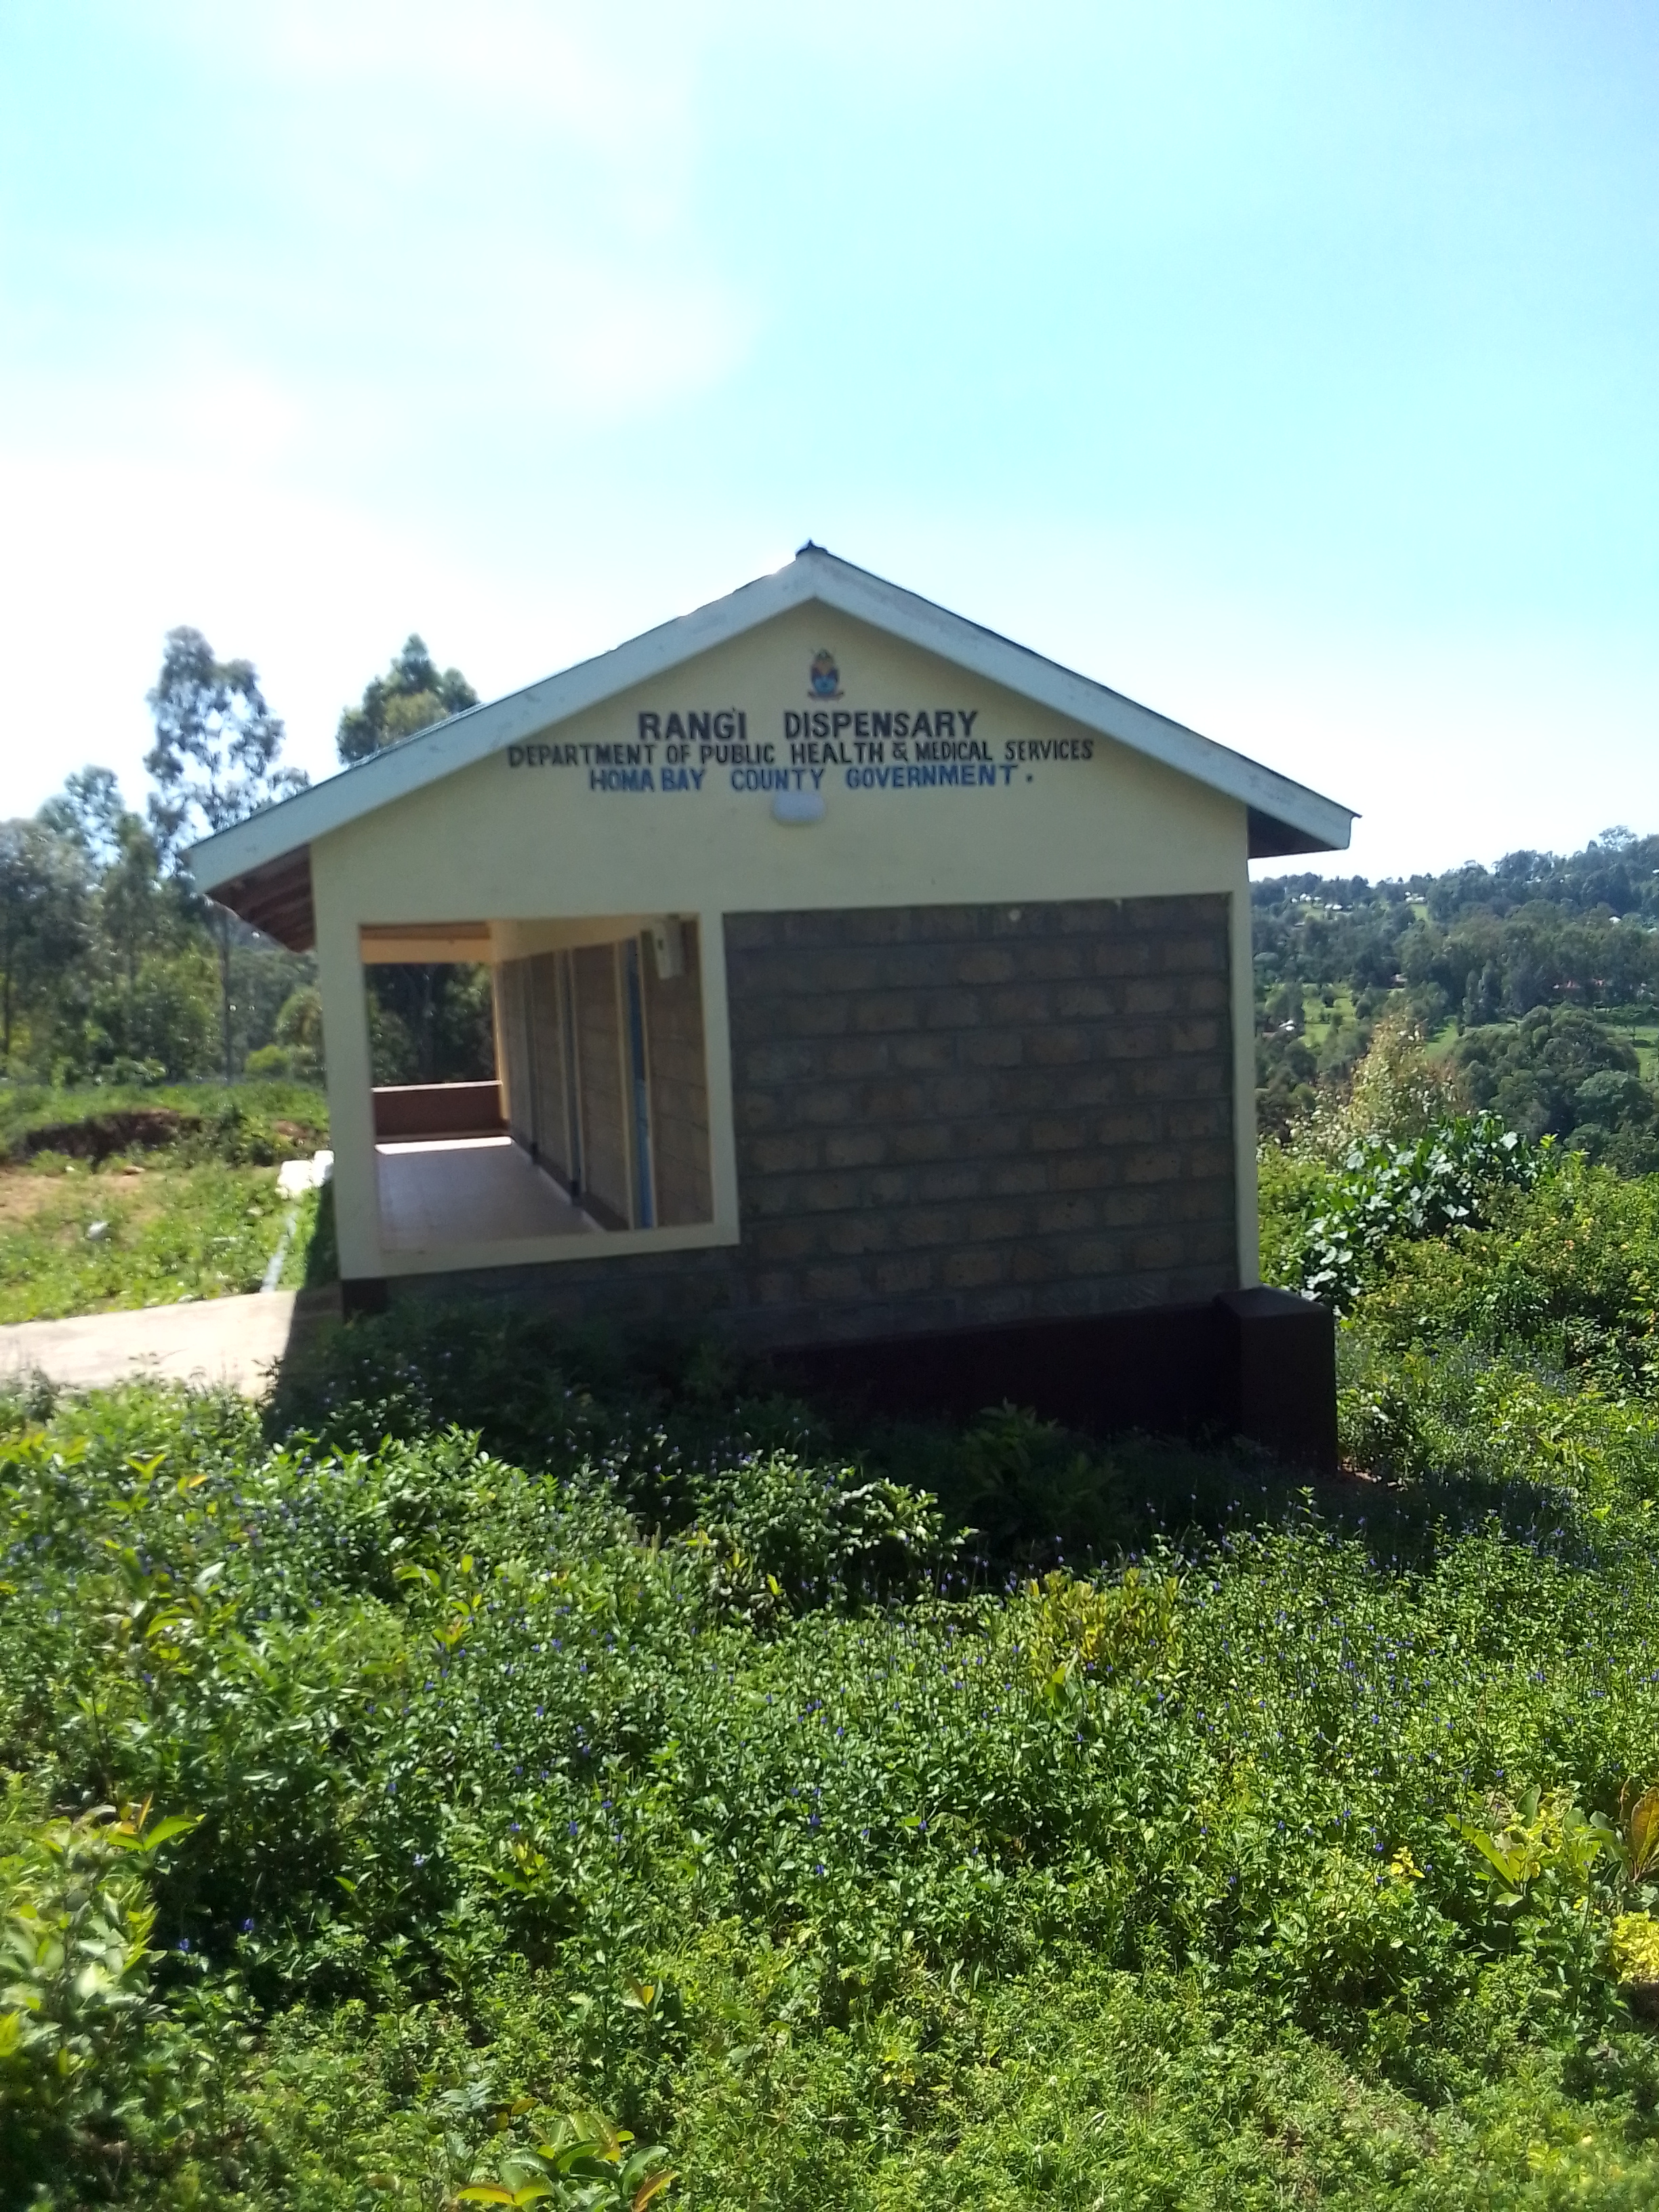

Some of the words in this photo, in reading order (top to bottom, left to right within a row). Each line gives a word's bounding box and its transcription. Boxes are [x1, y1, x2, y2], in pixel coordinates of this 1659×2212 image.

[638, 711, 747, 740] RANGI
[784, 710, 979, 739] DISPENSARY
[508, 744, 655, 767] DEPARTMENT
[666, 744, 691, 765] OF
[701, 743, 775, 765] PUBLIC
[791, 741, 883, 765] HEALTH
[893, 741, 909, 762] &
[915, 740, 994, 763] MEDICAL
[1004, 739, 1094, 762] SERVICES
[590, 767, 656, 792] HOMA
[660, 767, 706, 792] BAY
[731, 766, 825, 792] COUNTY
